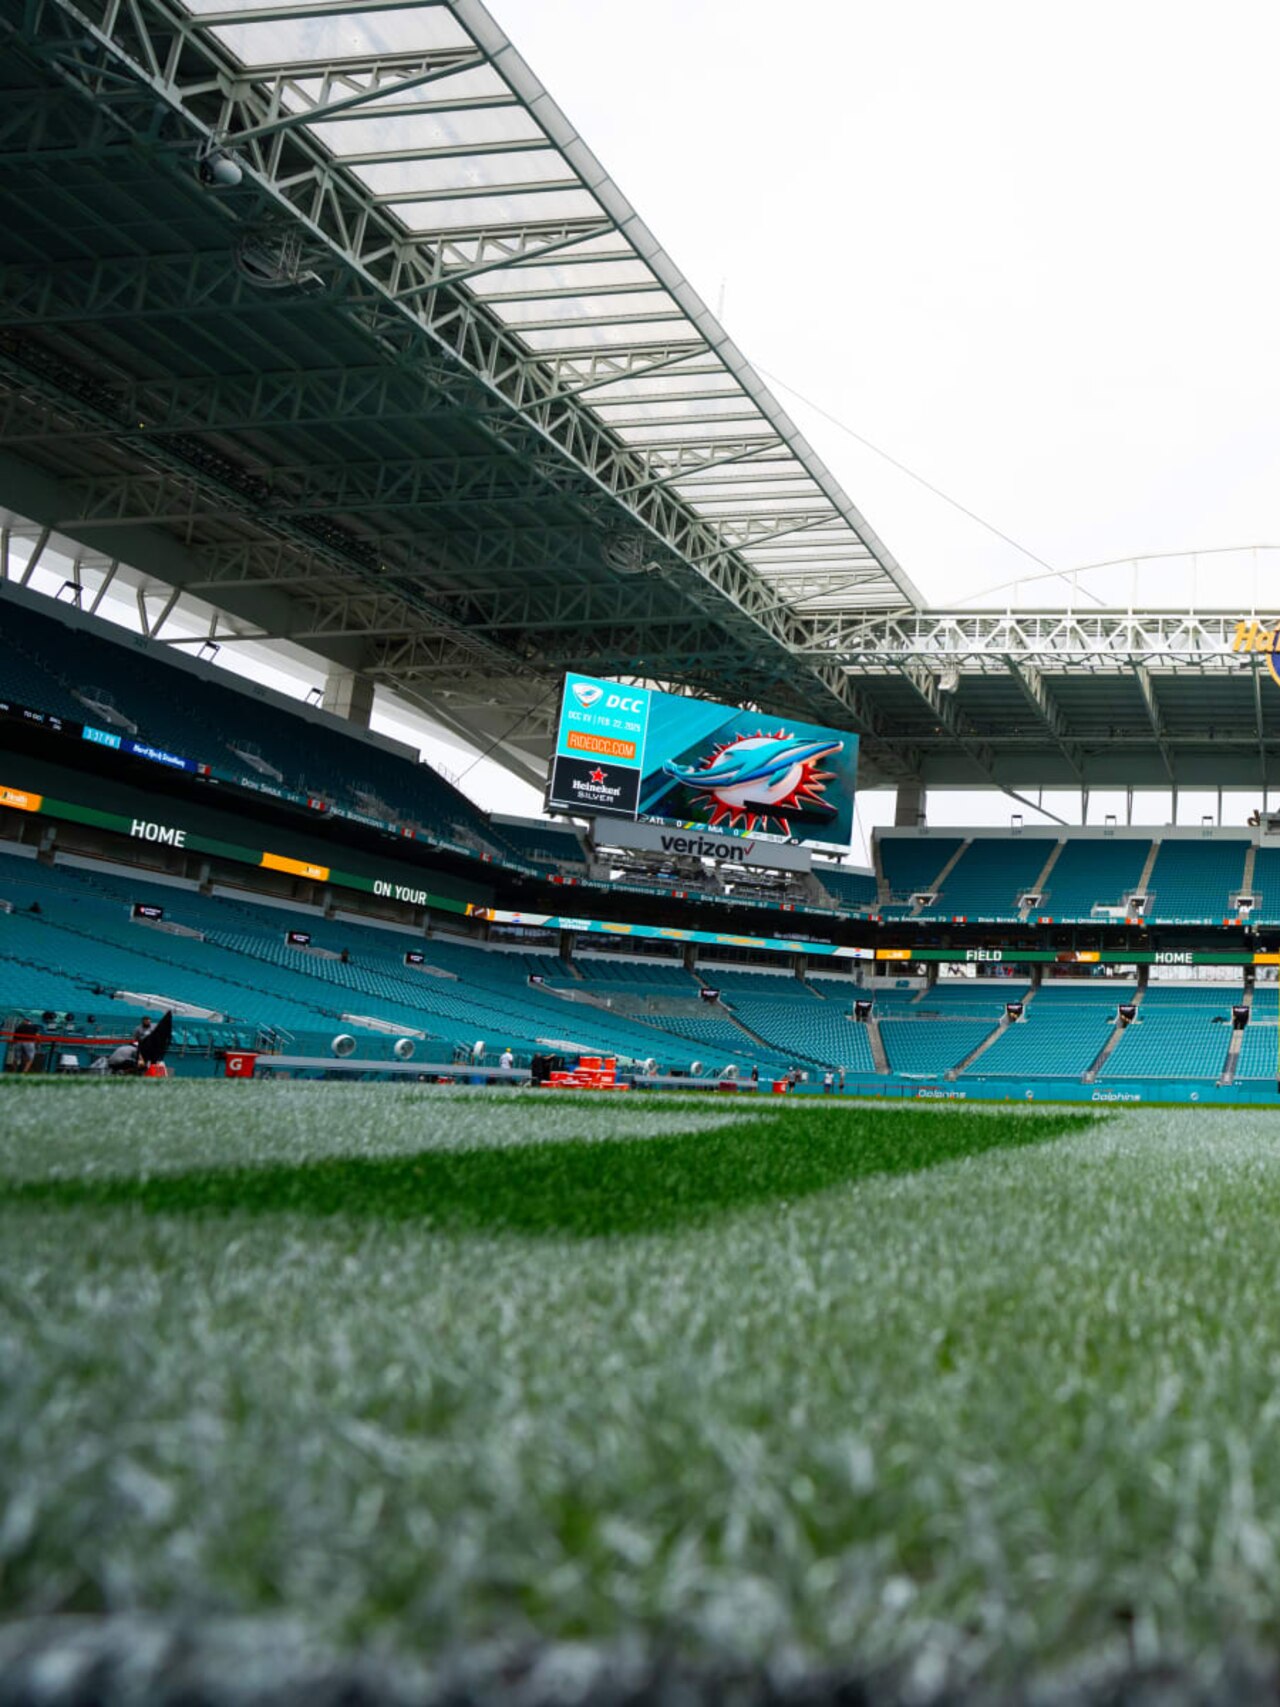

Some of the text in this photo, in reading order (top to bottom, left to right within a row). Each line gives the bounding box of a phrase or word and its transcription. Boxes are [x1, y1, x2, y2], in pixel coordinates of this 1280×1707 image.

[605, 694, 644, 713] DCC
[573, 780, 620, 797] Heineken
[577, 791, 614, 803] SILVER
[130, 819, 186, 848] HOME
[650, 815, 665, 826] ATL
[708, 825, 724, 835] MIA
[661, 836, 744, 861] verizon
[374, 880, 427, 906] ON YOUR
[966, 950, 1002, 961] FIELD
[1155, 952, 1193, 964] HOME
[229, 1058, 243, 1070] G
[1091, 1091, 1141, 1102] Dolphins
